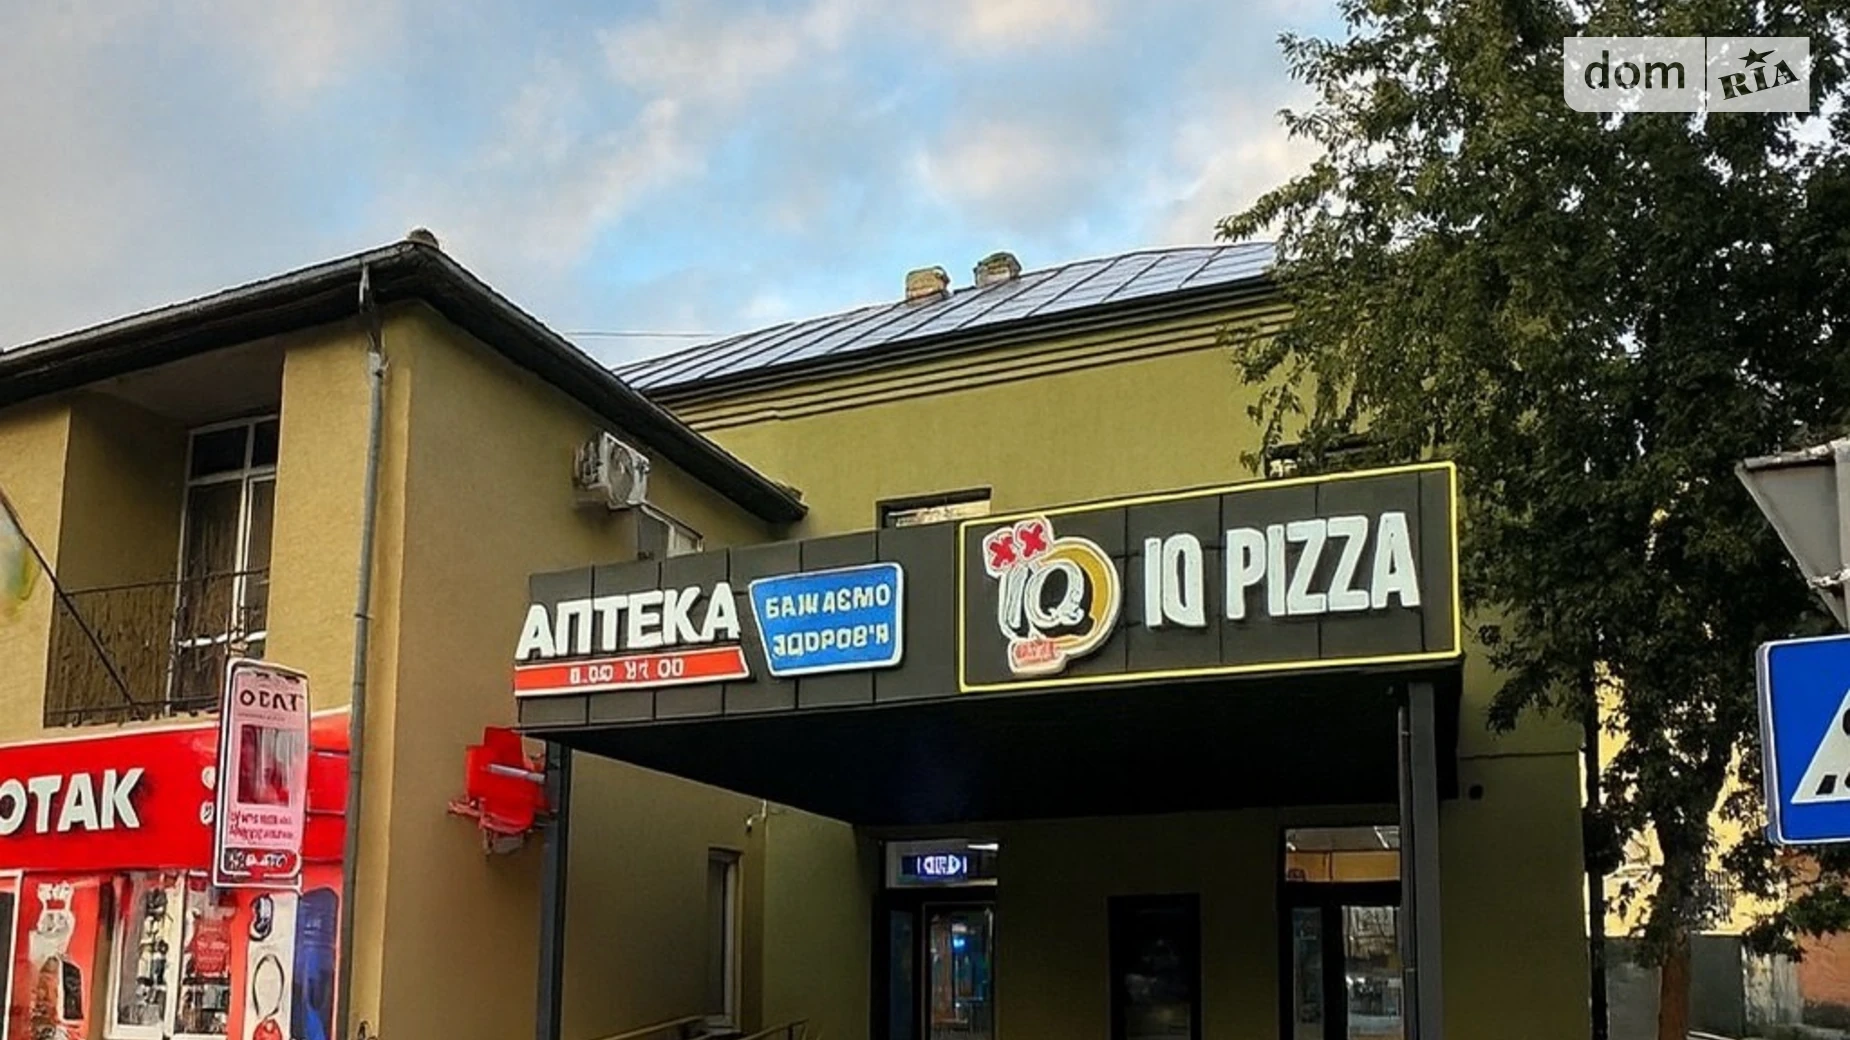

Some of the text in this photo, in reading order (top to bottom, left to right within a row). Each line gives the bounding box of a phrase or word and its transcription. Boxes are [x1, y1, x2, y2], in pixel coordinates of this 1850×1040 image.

[1145, 511, 1422, 628] IQ PIZZA
[515, 582, 741, 660] АПТЕКА
